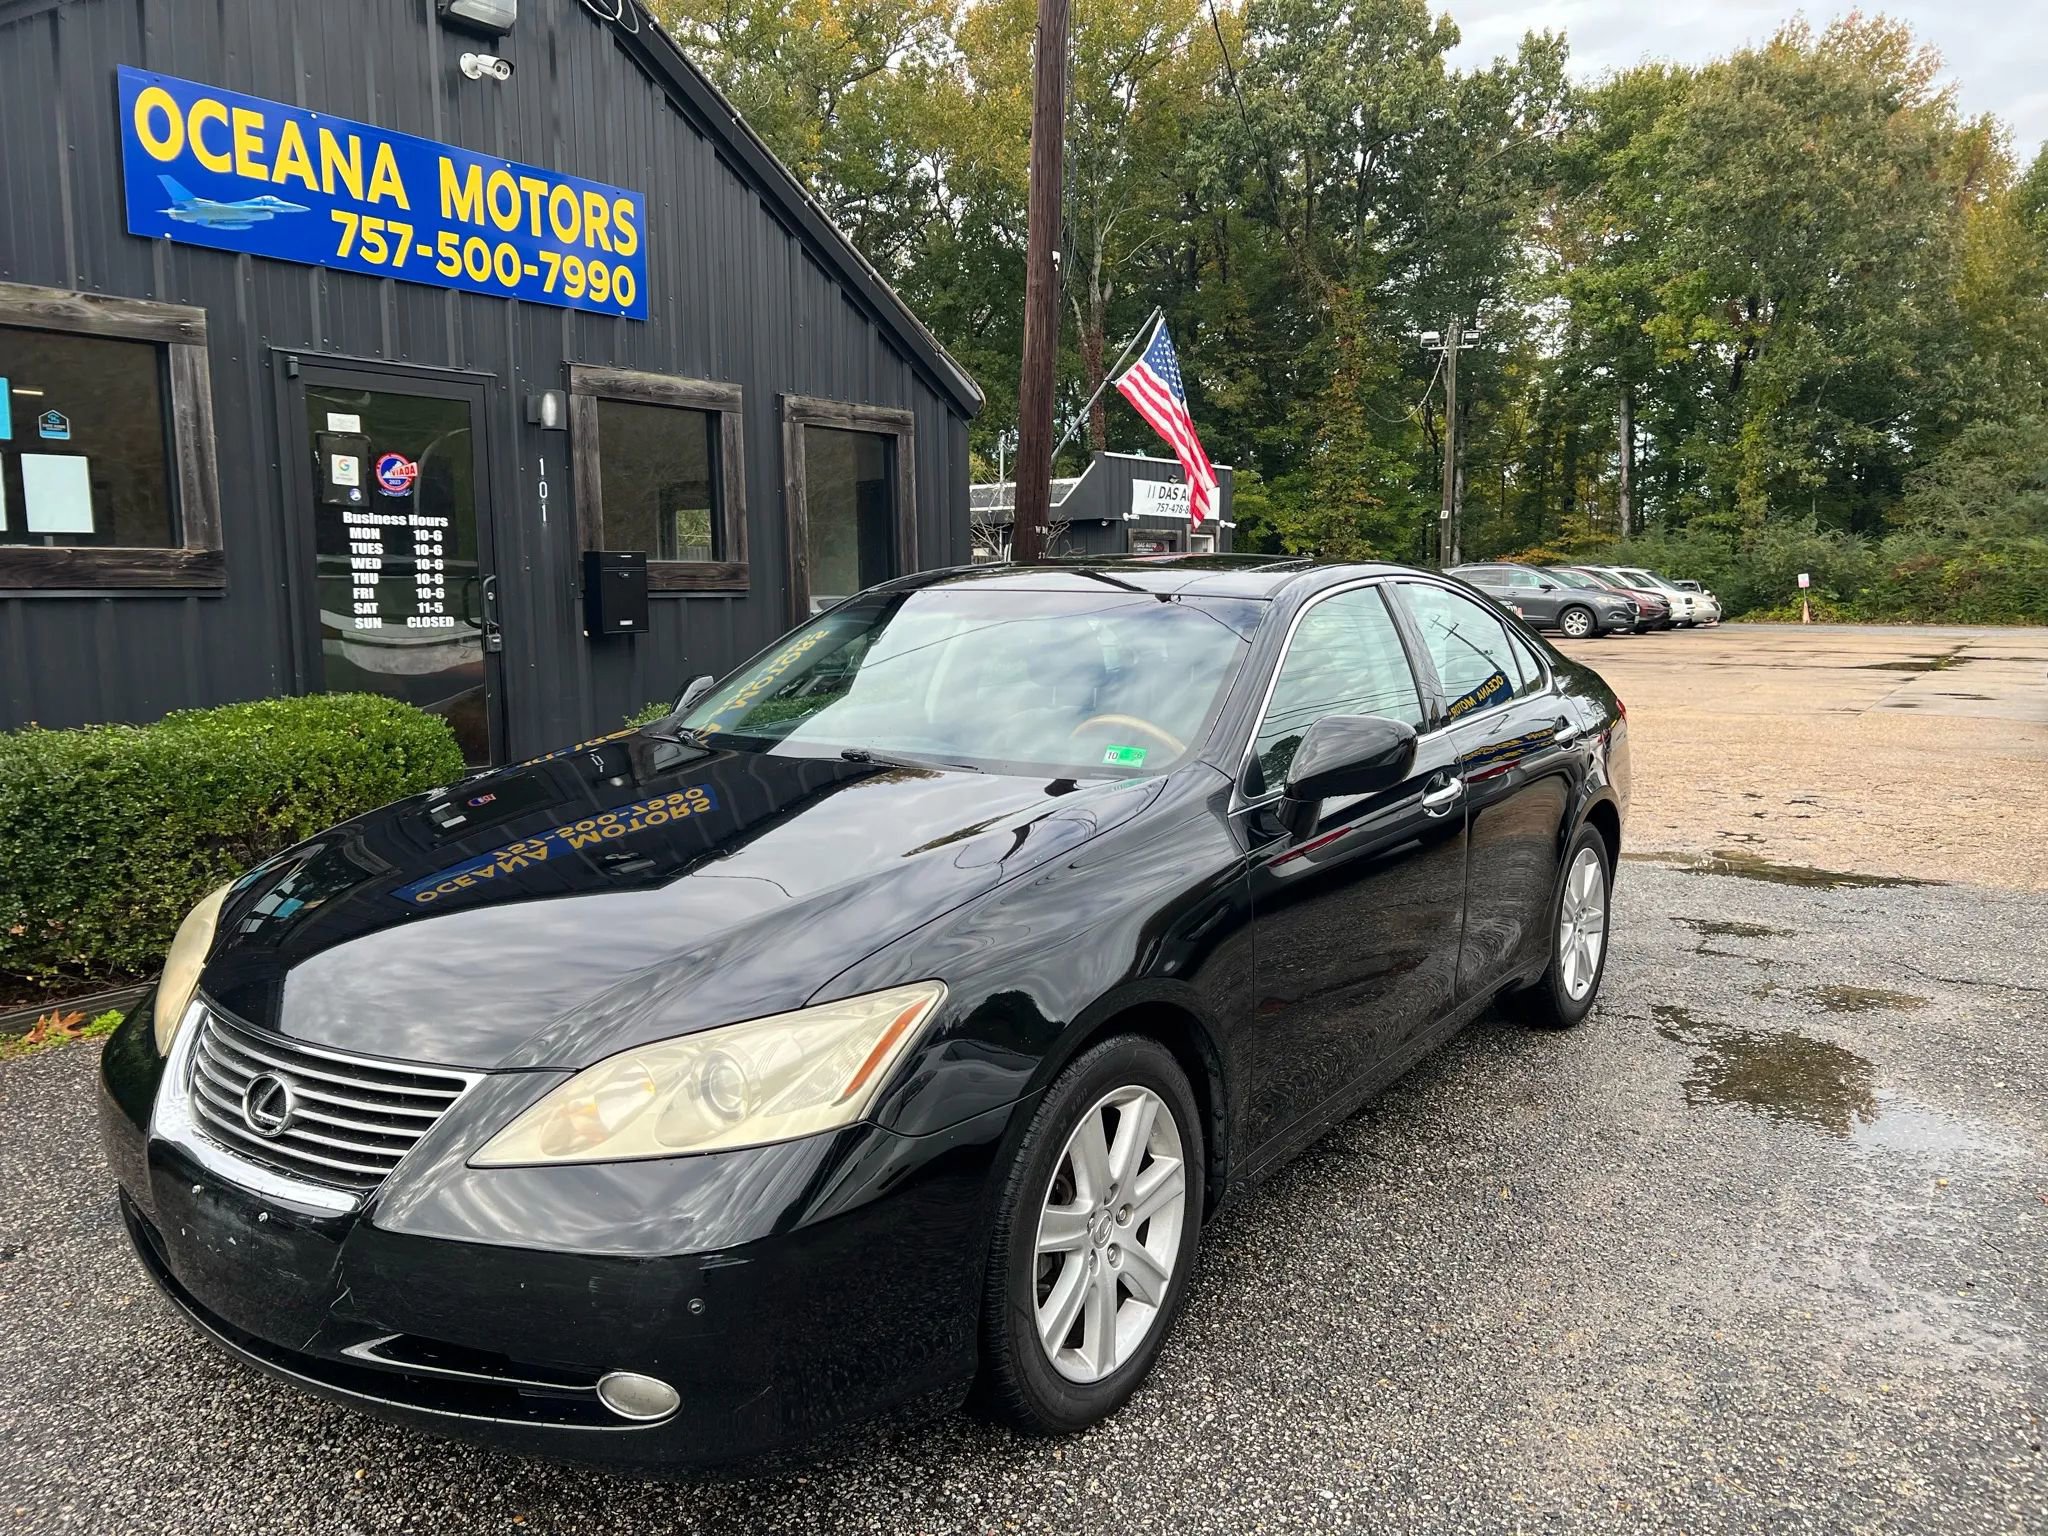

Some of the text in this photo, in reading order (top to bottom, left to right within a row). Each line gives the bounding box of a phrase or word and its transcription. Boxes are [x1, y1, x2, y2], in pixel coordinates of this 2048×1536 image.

[134, 86, 638, 256] OCEANA MOTORS
[331, 210, 635, 308] 757-500-7990
[539, 457, 548, 522] 101
[1158, 486, 1179, 501] DAS
[1155, 502, 1189, 514] 757-478-8
[343, 511, 448, 527] Business Hours
[350, 527, 442, 541] MON 10-6
[350, 542, 442, 556] TUES 10-6
[351, 557, 443, 571] WED 10-6
[352, 572, 443, 585] THU 10-6
[353, 587, 445, 600] FRI 10-6
[353, 602, 443, 614] SAT 11-5
[355, 616, 454, 629] SUN CLOSED
